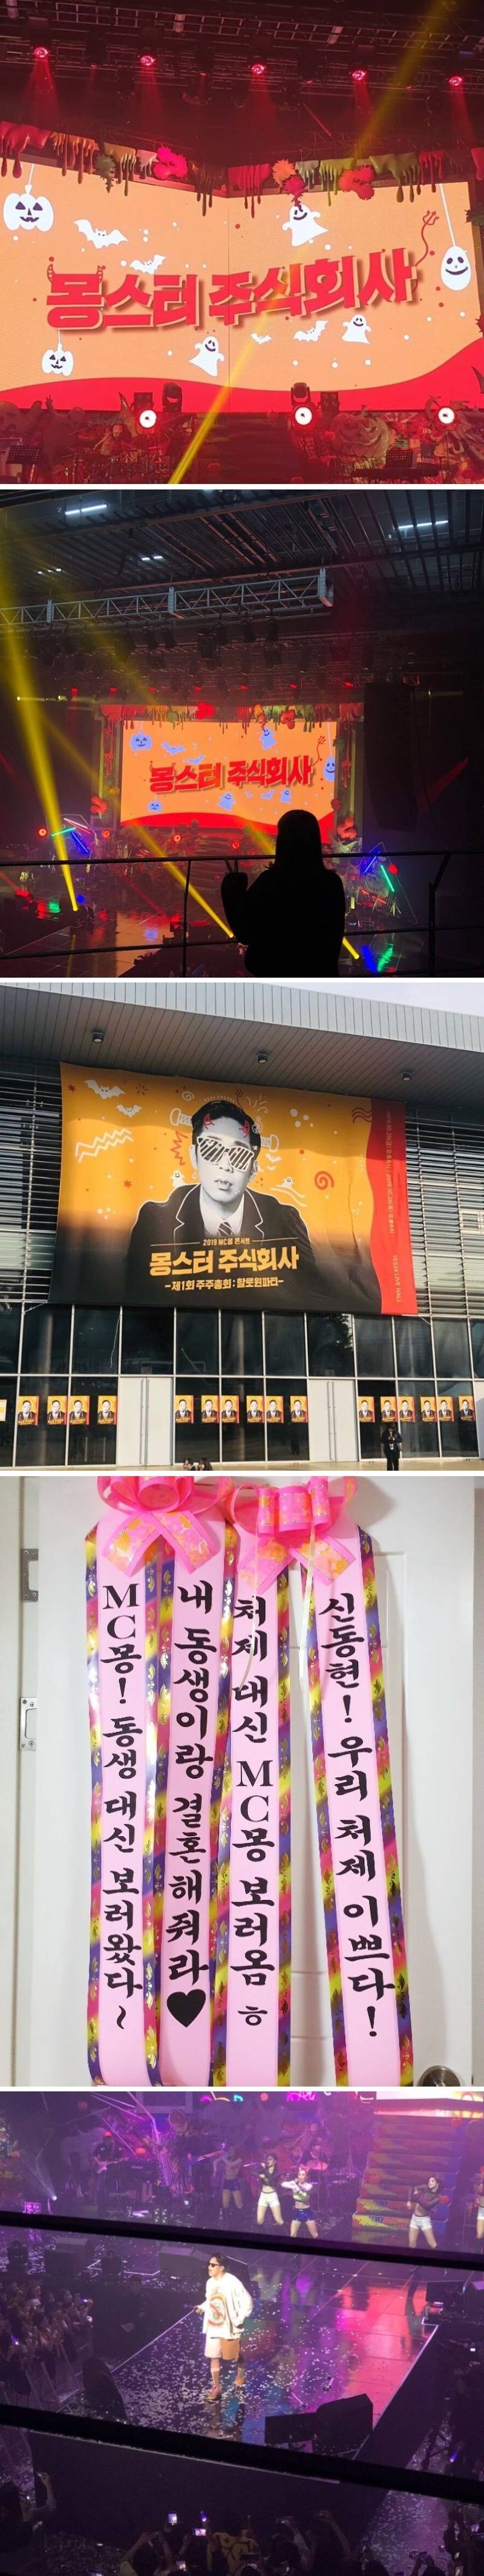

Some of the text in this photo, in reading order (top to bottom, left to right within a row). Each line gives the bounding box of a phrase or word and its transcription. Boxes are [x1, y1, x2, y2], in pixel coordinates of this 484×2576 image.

[47, 247, 413, 330] 몽스터 주식회사
[149, 755, 312, 793] 몽스터 주식회사
[150, 1246, 299, 1276] 몽스터 주식회사
[177, 1580, 214, 1615] 내
[100, 1583, 142, 1704] MC몽!
[318, 1593, 365, 1723] 신동현!
[173, 1627, 217, 1779] 동생이랑
[102, 1716, 143, 1779] 동생
[327, 1736, 373, 1801] 우리
[103, 1791, 137, 1854] 대신
[230, 1595, 275, 2026] 처제 대신 MC몽 보러옴 ㅎ
[335, 1815, 376, 1881] 처제
